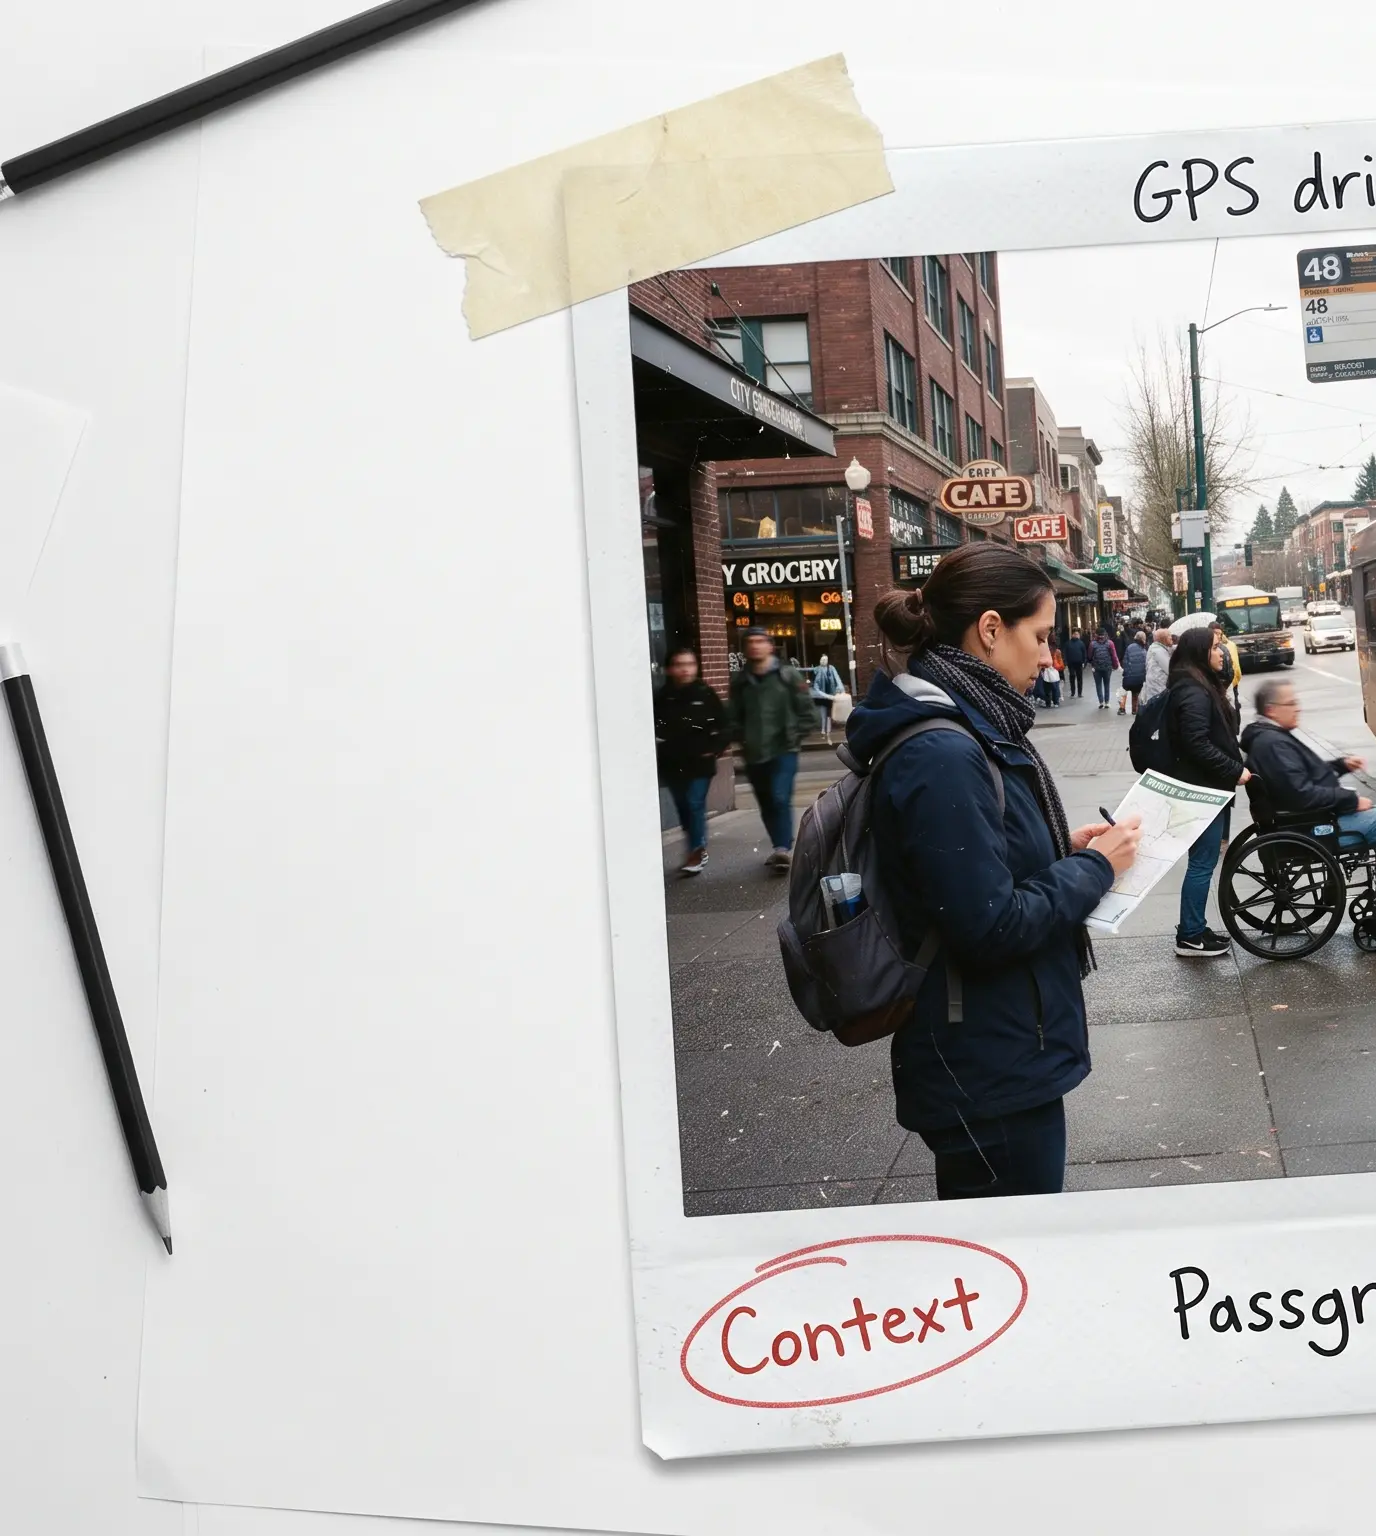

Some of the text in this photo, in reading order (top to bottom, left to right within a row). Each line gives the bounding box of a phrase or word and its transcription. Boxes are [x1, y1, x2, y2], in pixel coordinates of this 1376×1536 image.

[1133, 156, 1259, 223] GPS
[1304, 255, 1341, 281] 48
[1305, 298, 1328, 315] 48
[950, 482, 1022, 507] CAFE
[1017, 519, 1062, 539] CAFE
[742, 558, 839, 586] GROCERY
[721, 1277, 980, 1375] Context
